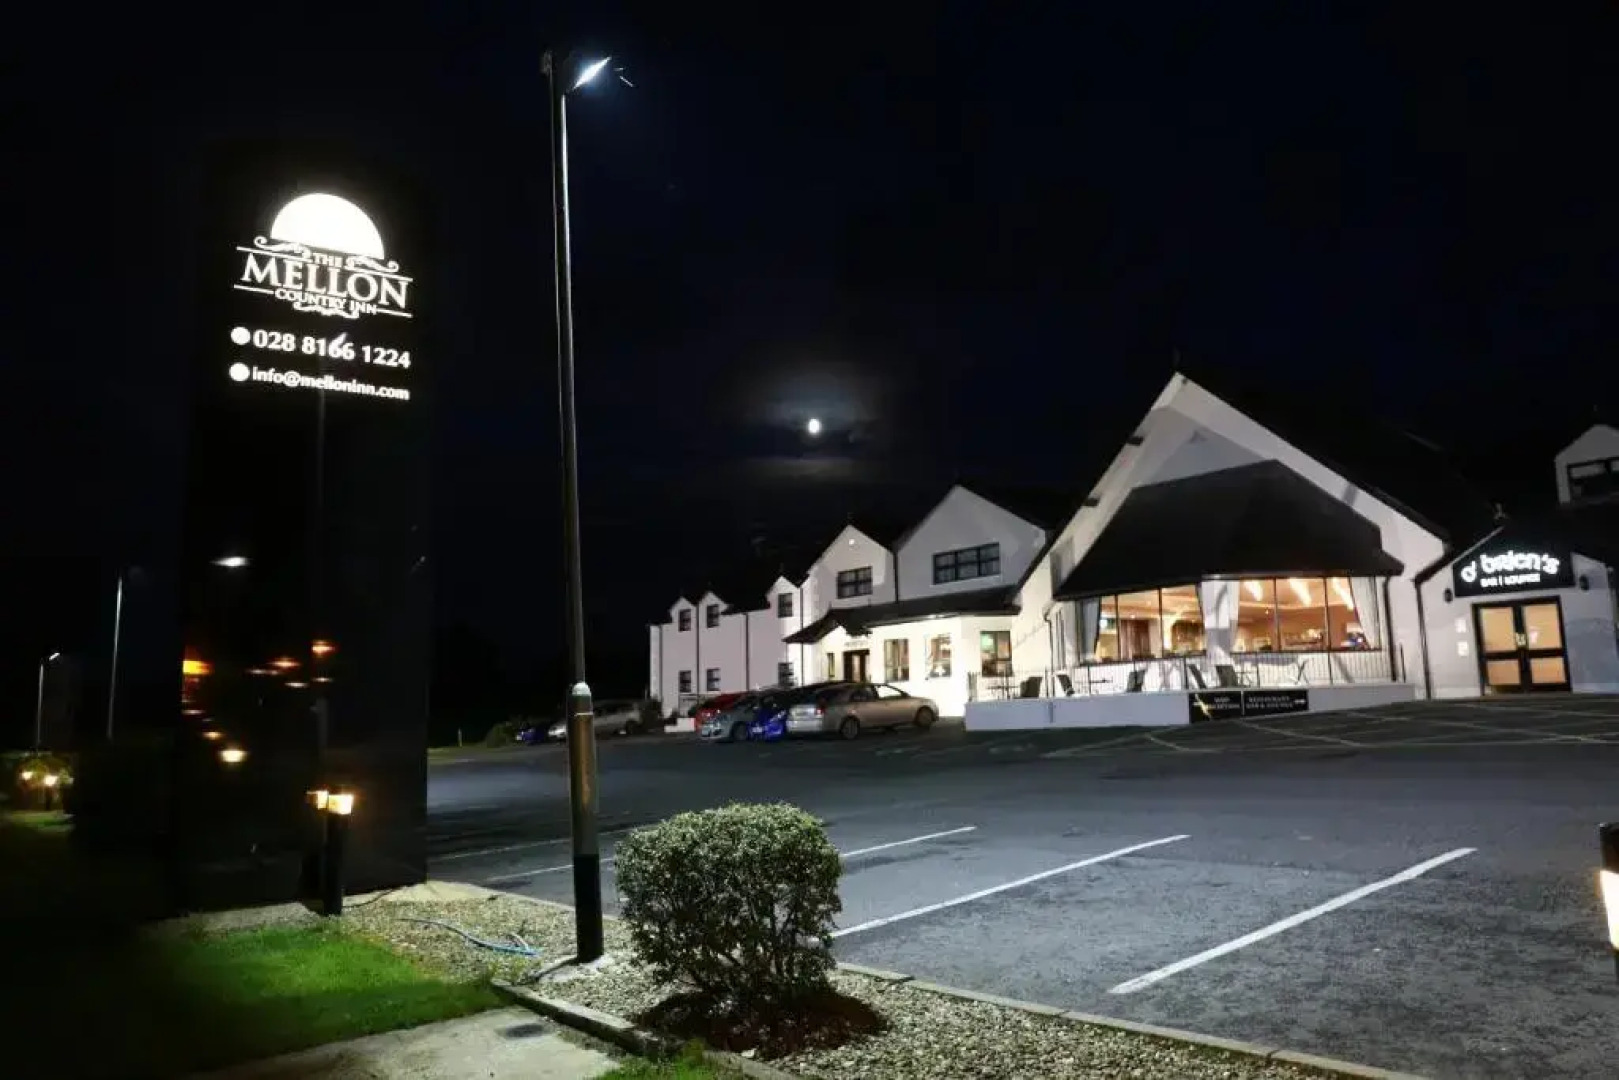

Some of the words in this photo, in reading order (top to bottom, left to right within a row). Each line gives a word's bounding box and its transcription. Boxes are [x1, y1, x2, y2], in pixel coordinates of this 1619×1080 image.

[312, 253, 343, 267] THE
[241, 252, 409, 309] MELLON
[275, 289, 347, 309] COUNTRY
[350, 301, 377, 315] INN
[253, 329, 296, 352] 028
[301, 332, 355, 360] 8166
[362, 345, 411, 369] 1224
[252, 366, 410, 400] info@melloninn.com
